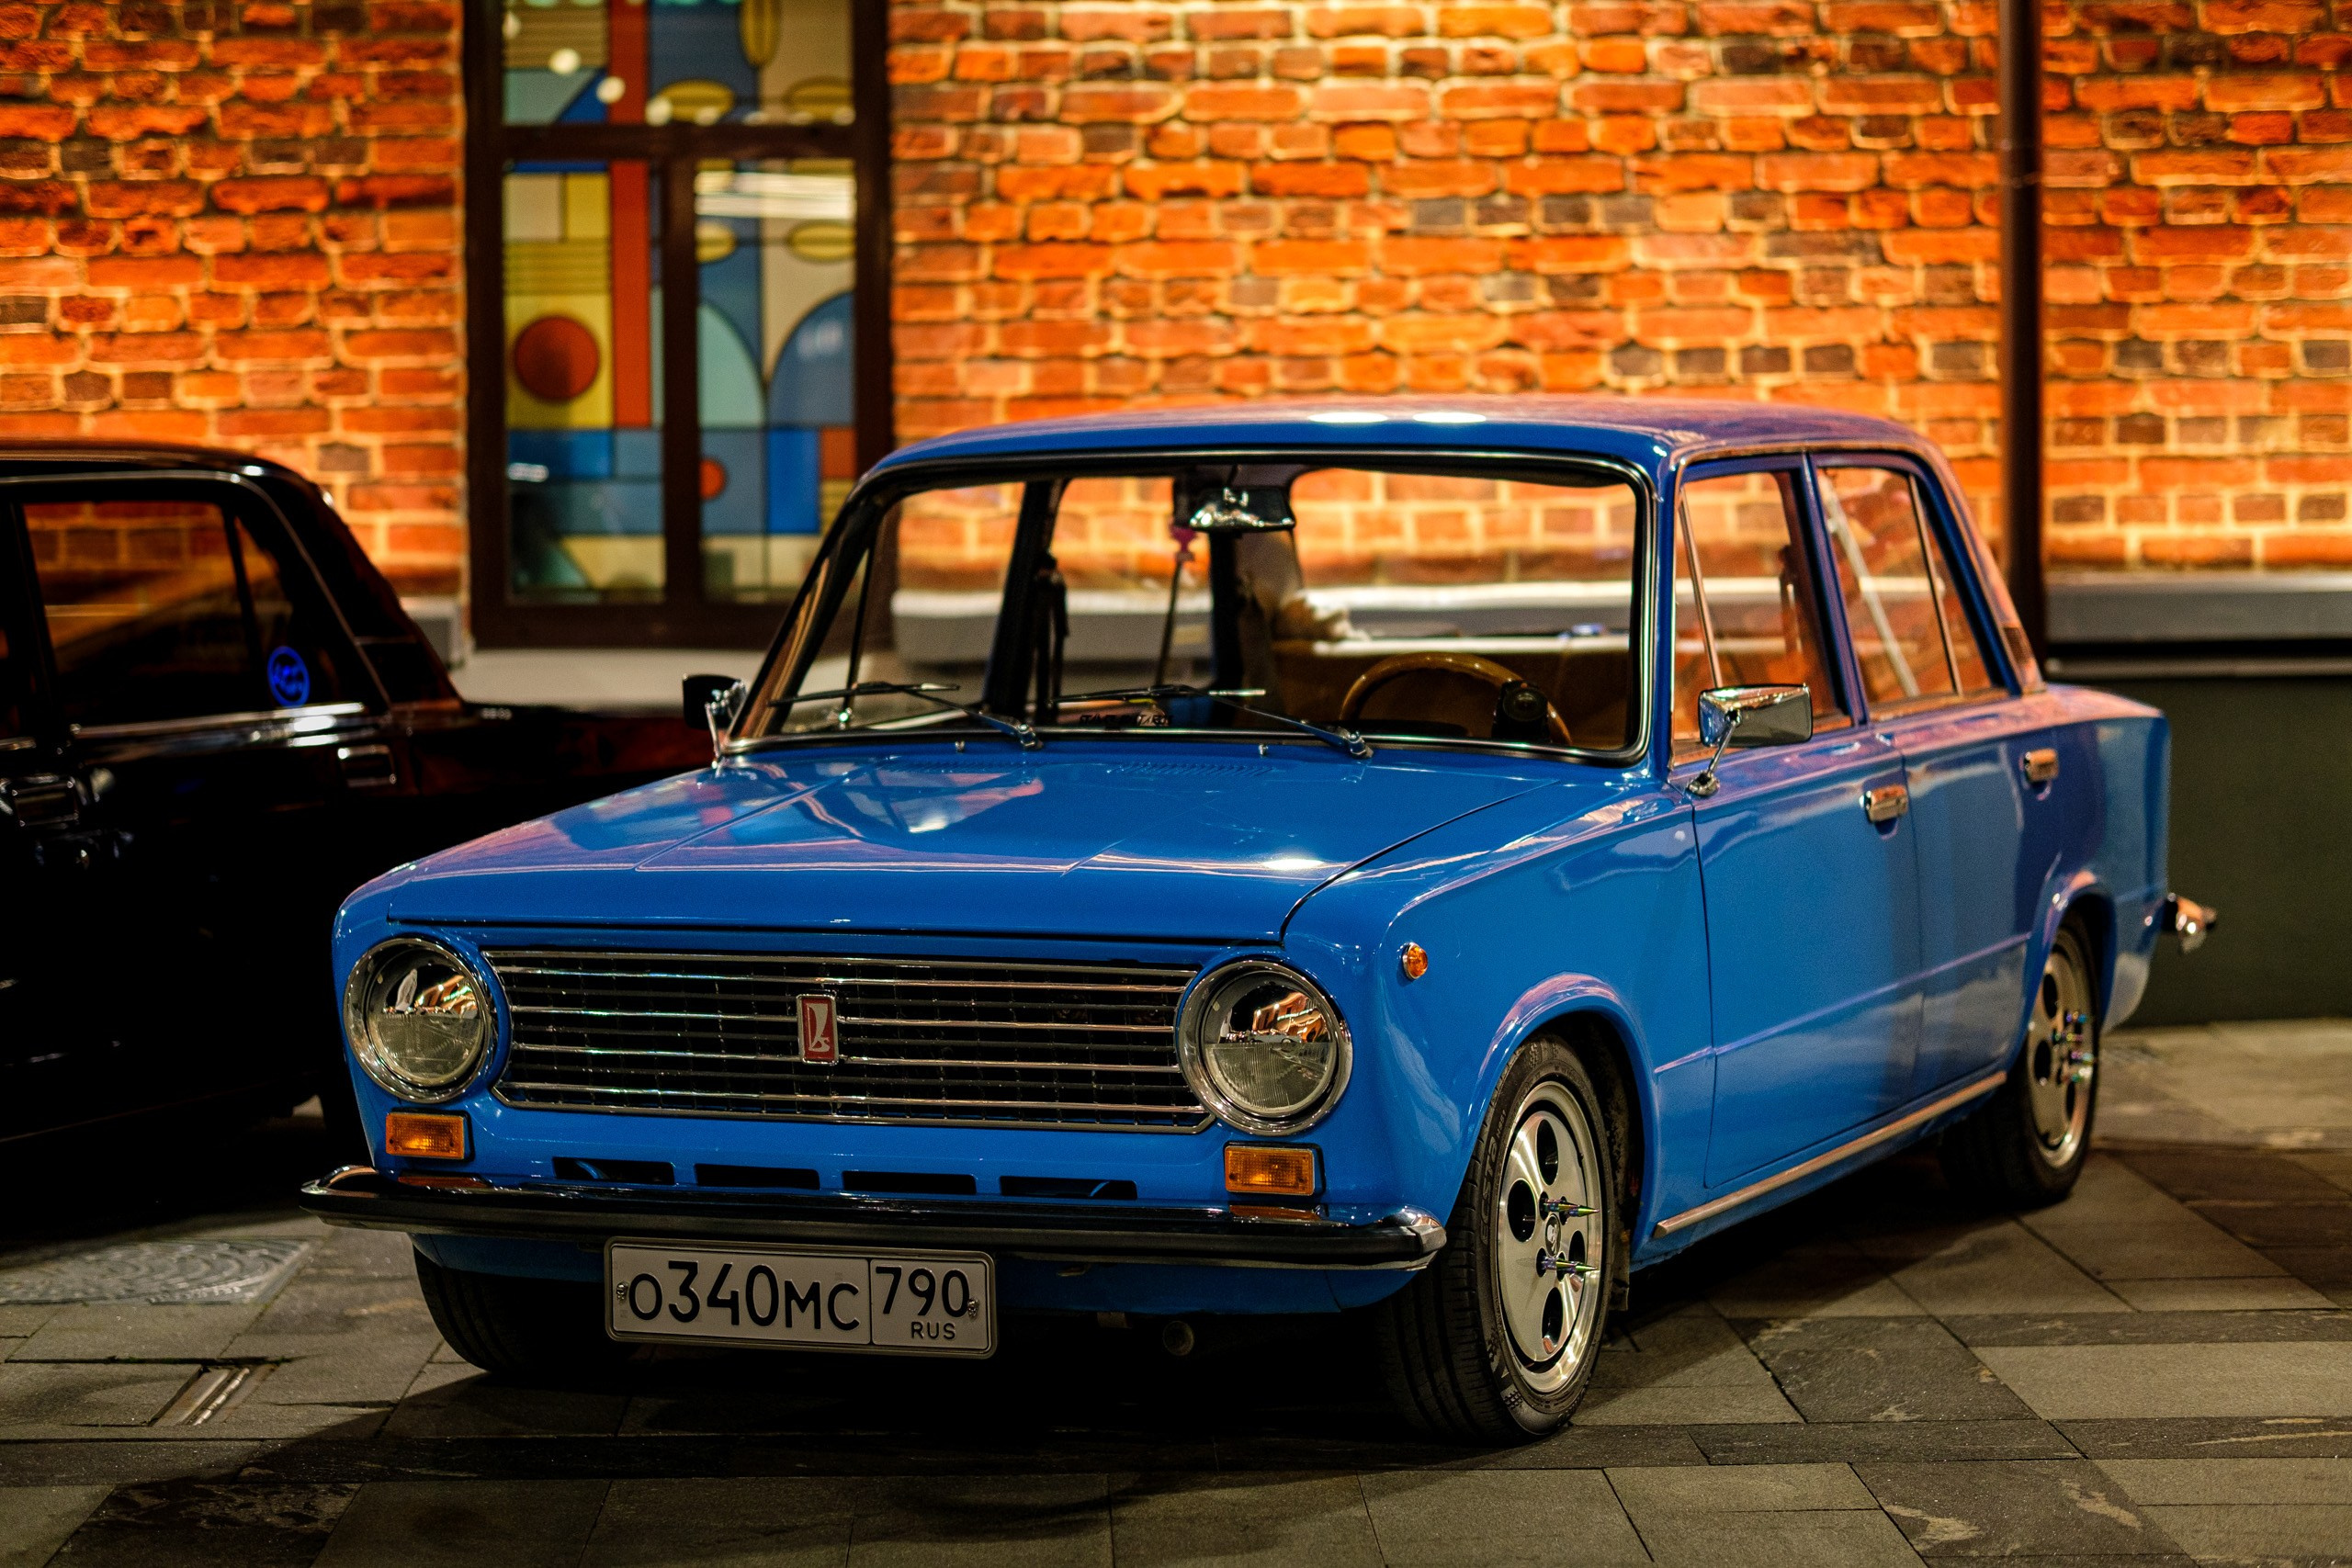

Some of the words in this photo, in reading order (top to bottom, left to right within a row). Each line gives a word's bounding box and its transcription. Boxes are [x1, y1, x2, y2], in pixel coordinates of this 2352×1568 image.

[628, 1260, 860, 1330] O340MC
[876, 1266, 970, 1318] 790
[910, 1321, 956, 1340] RUS
